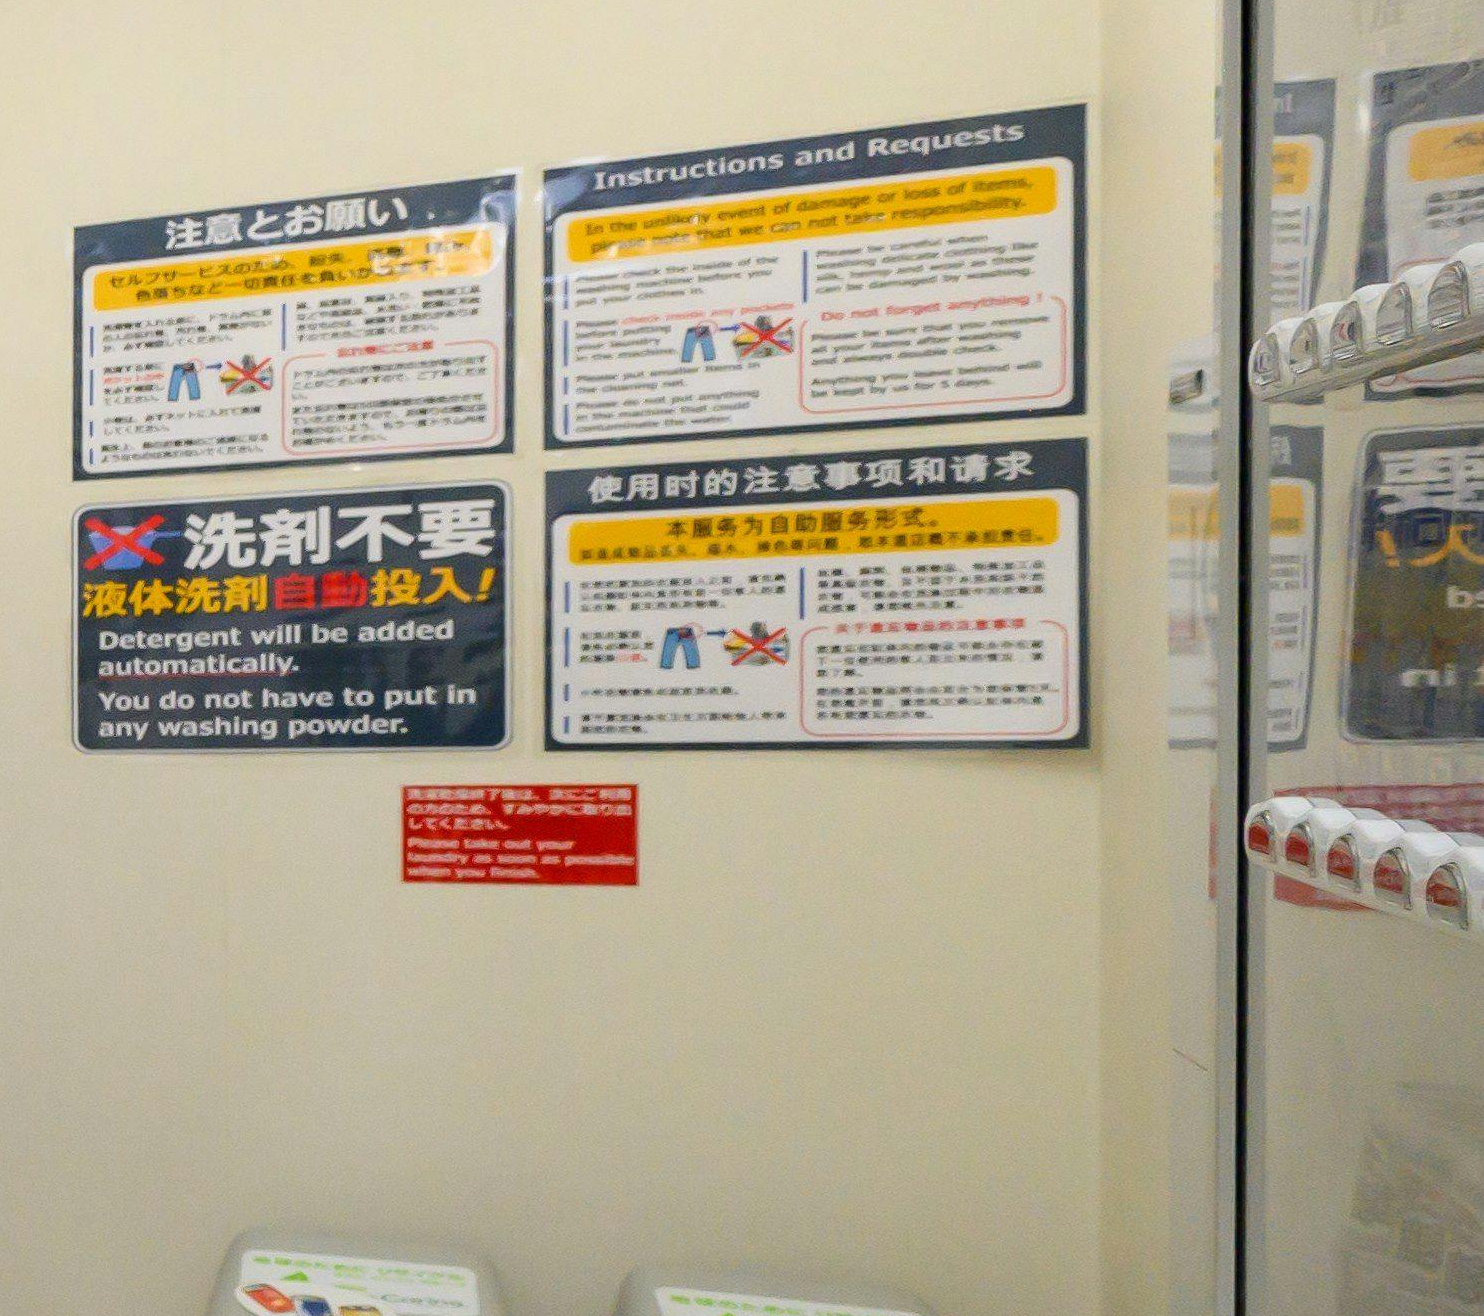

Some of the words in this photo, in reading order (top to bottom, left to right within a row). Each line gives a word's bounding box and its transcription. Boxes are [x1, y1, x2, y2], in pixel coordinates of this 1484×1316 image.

[594, 153, 784, 192] Instructions
[795, 144, 855, 167] and
[868, 121, 1024, 158] Requests
[166, 197, 409, 250] 注意とお願い
[609, 217, 637, 232] the
[717, 204, 766, 221] event
[773, 201, 791, 215] of
[796, 192, 870, 213] damage
[903, 184, 940, 200] loss
[588, 450, 1035, 504] 使用时的注意事项和请求
[183, 498, 496, 571] 洗剤不要
[99, 627, 241, 652] Detergent
[251, 624, 301, 645] will
[311, 623, 348, 644] be
[358, 620, 454, 642] added
[99, 654, 300, 677] automatically.
[99, 691, 150, 711] You
[159, 690, 195, 710] do
[204, 689, 252, 710] not
[262, 687, 333, 708] have
[343, 686, 374, 707] to
[384, 686, 436, 710] put
[447, 685, 476, 706] in
[99, 720, 148, 741] any
[158, 716, 277, 740] washing
[288, 714, 409, 739] powder.
